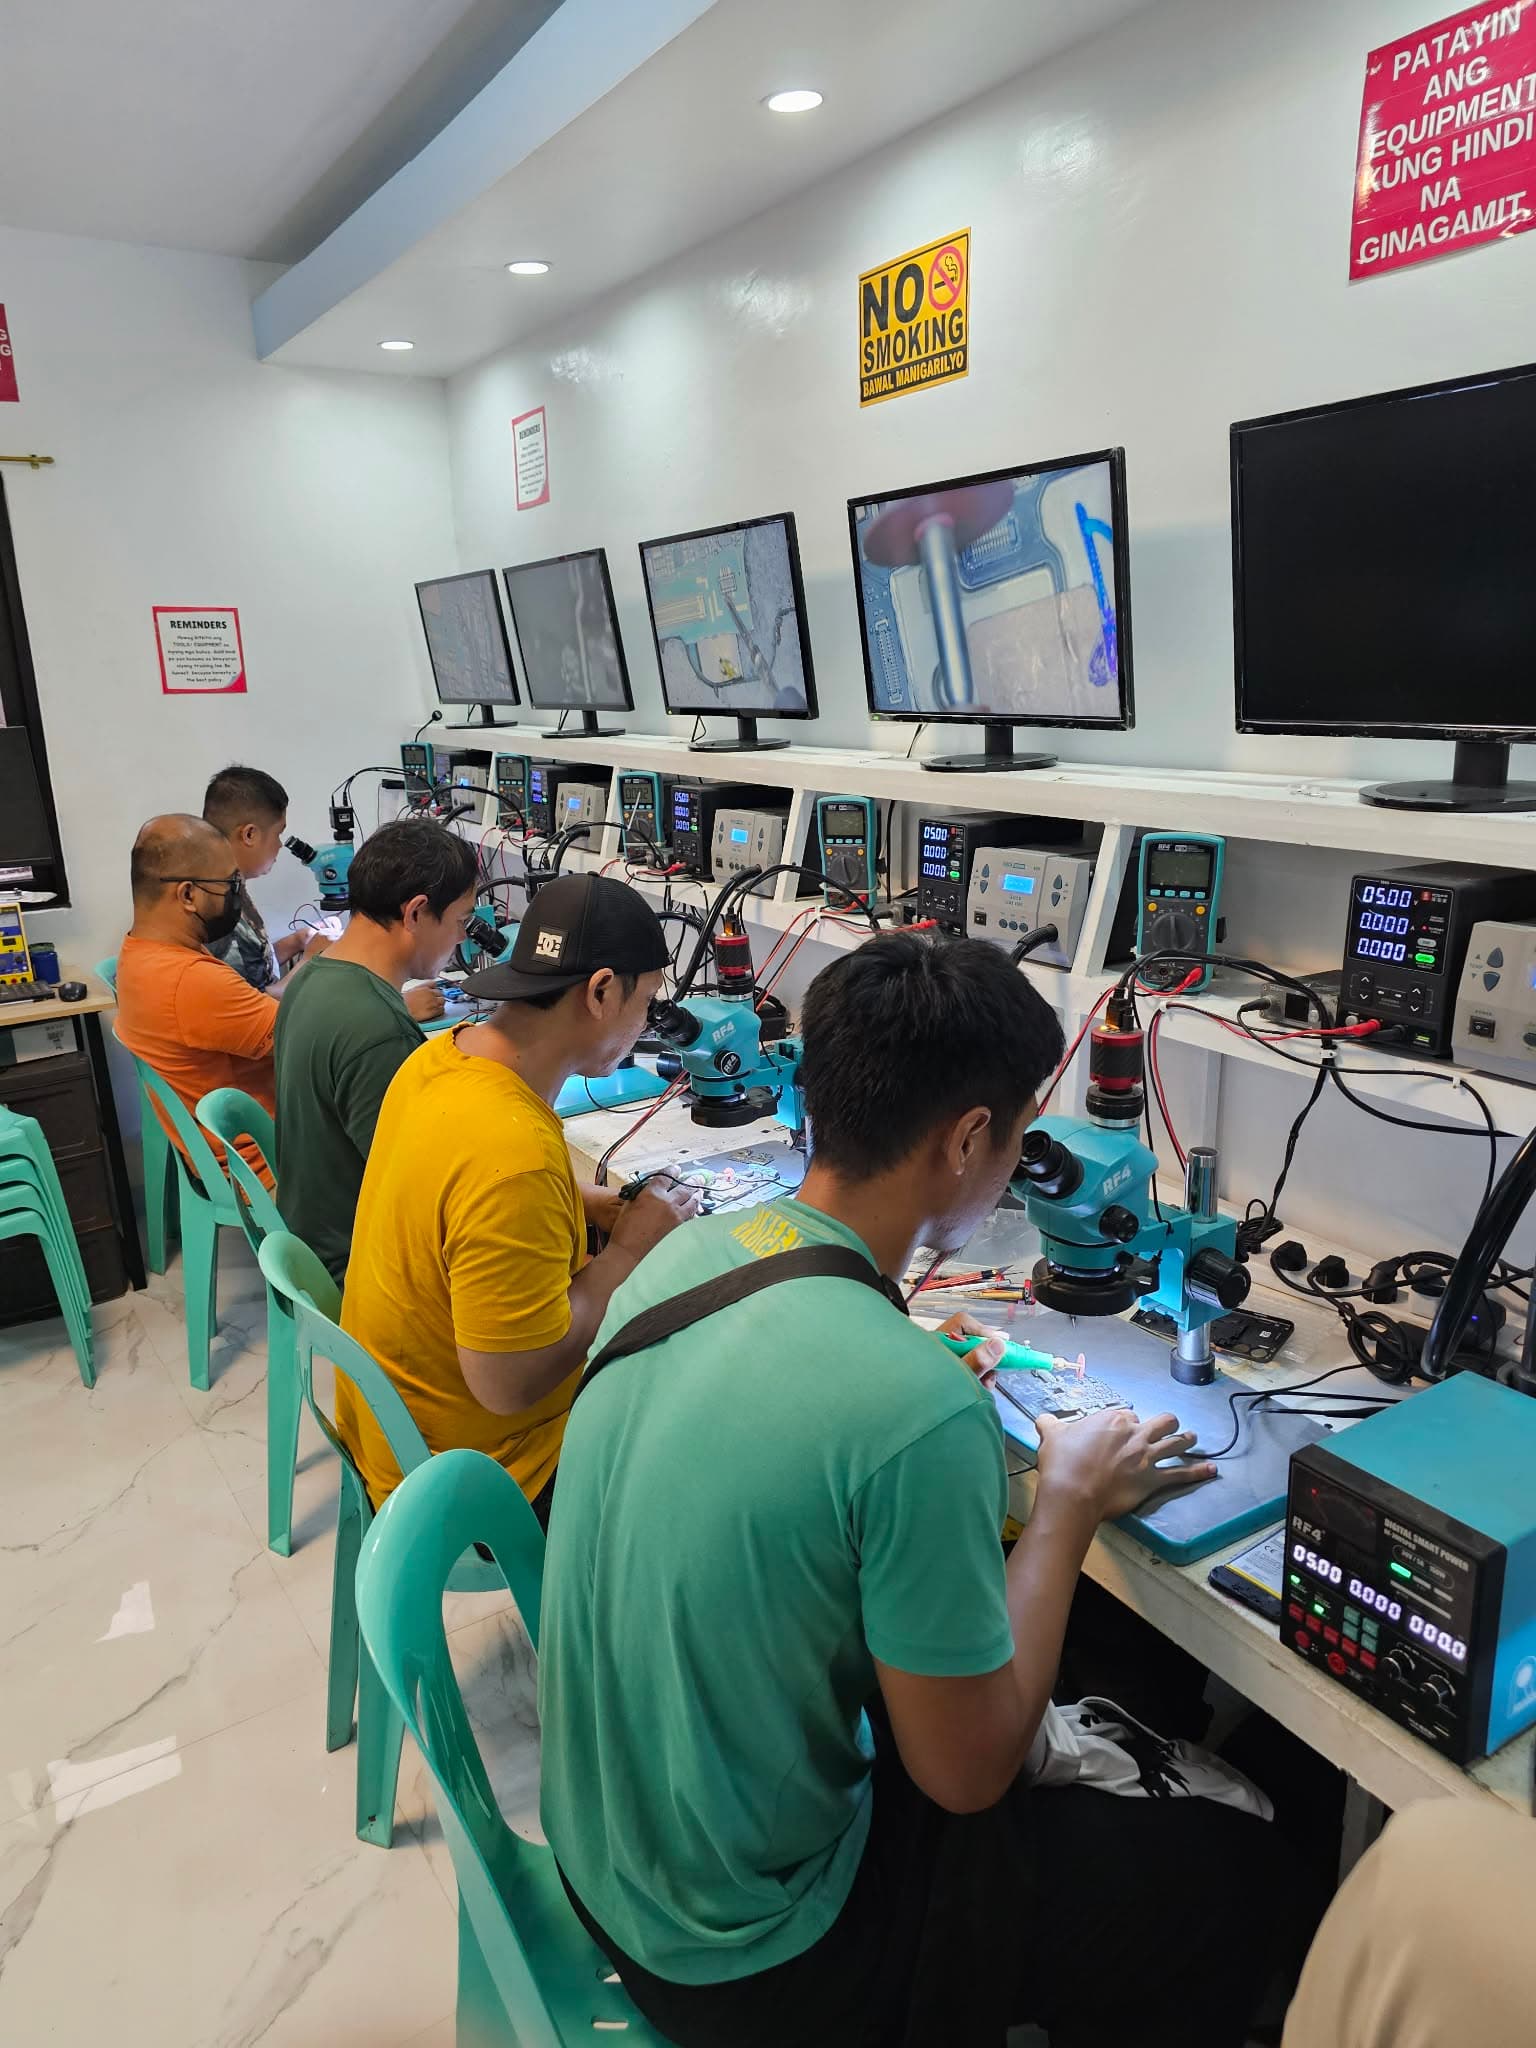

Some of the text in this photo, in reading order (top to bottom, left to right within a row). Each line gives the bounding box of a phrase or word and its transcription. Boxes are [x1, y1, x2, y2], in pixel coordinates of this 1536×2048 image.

[1393, 3, 1522, 81] PATAYIN
[1423, 56, 1489, 105] ANG
[1369, 74, 1536, 160] EQUIPMENT
[1451, 112, 1533, 167] HINDI
[1368, 146, 1442, 192] KUNG
[1420, 176, 1462, 213] NA
[1359, 191, 1526, 264] GINAGAMIT
[862, 263, 925, 338] NO
[863, 308, 964, 373] SMOKING
[863, 351, 964, 397] BAWAL MANIGARILYO
[170, 620, 227, 629] REMINDERS
[712, 1020, 735, 1043] RF4
[1103, 1164, 1131, 1195] RF4
[1292, 1516, 1322, 1541] RF4
